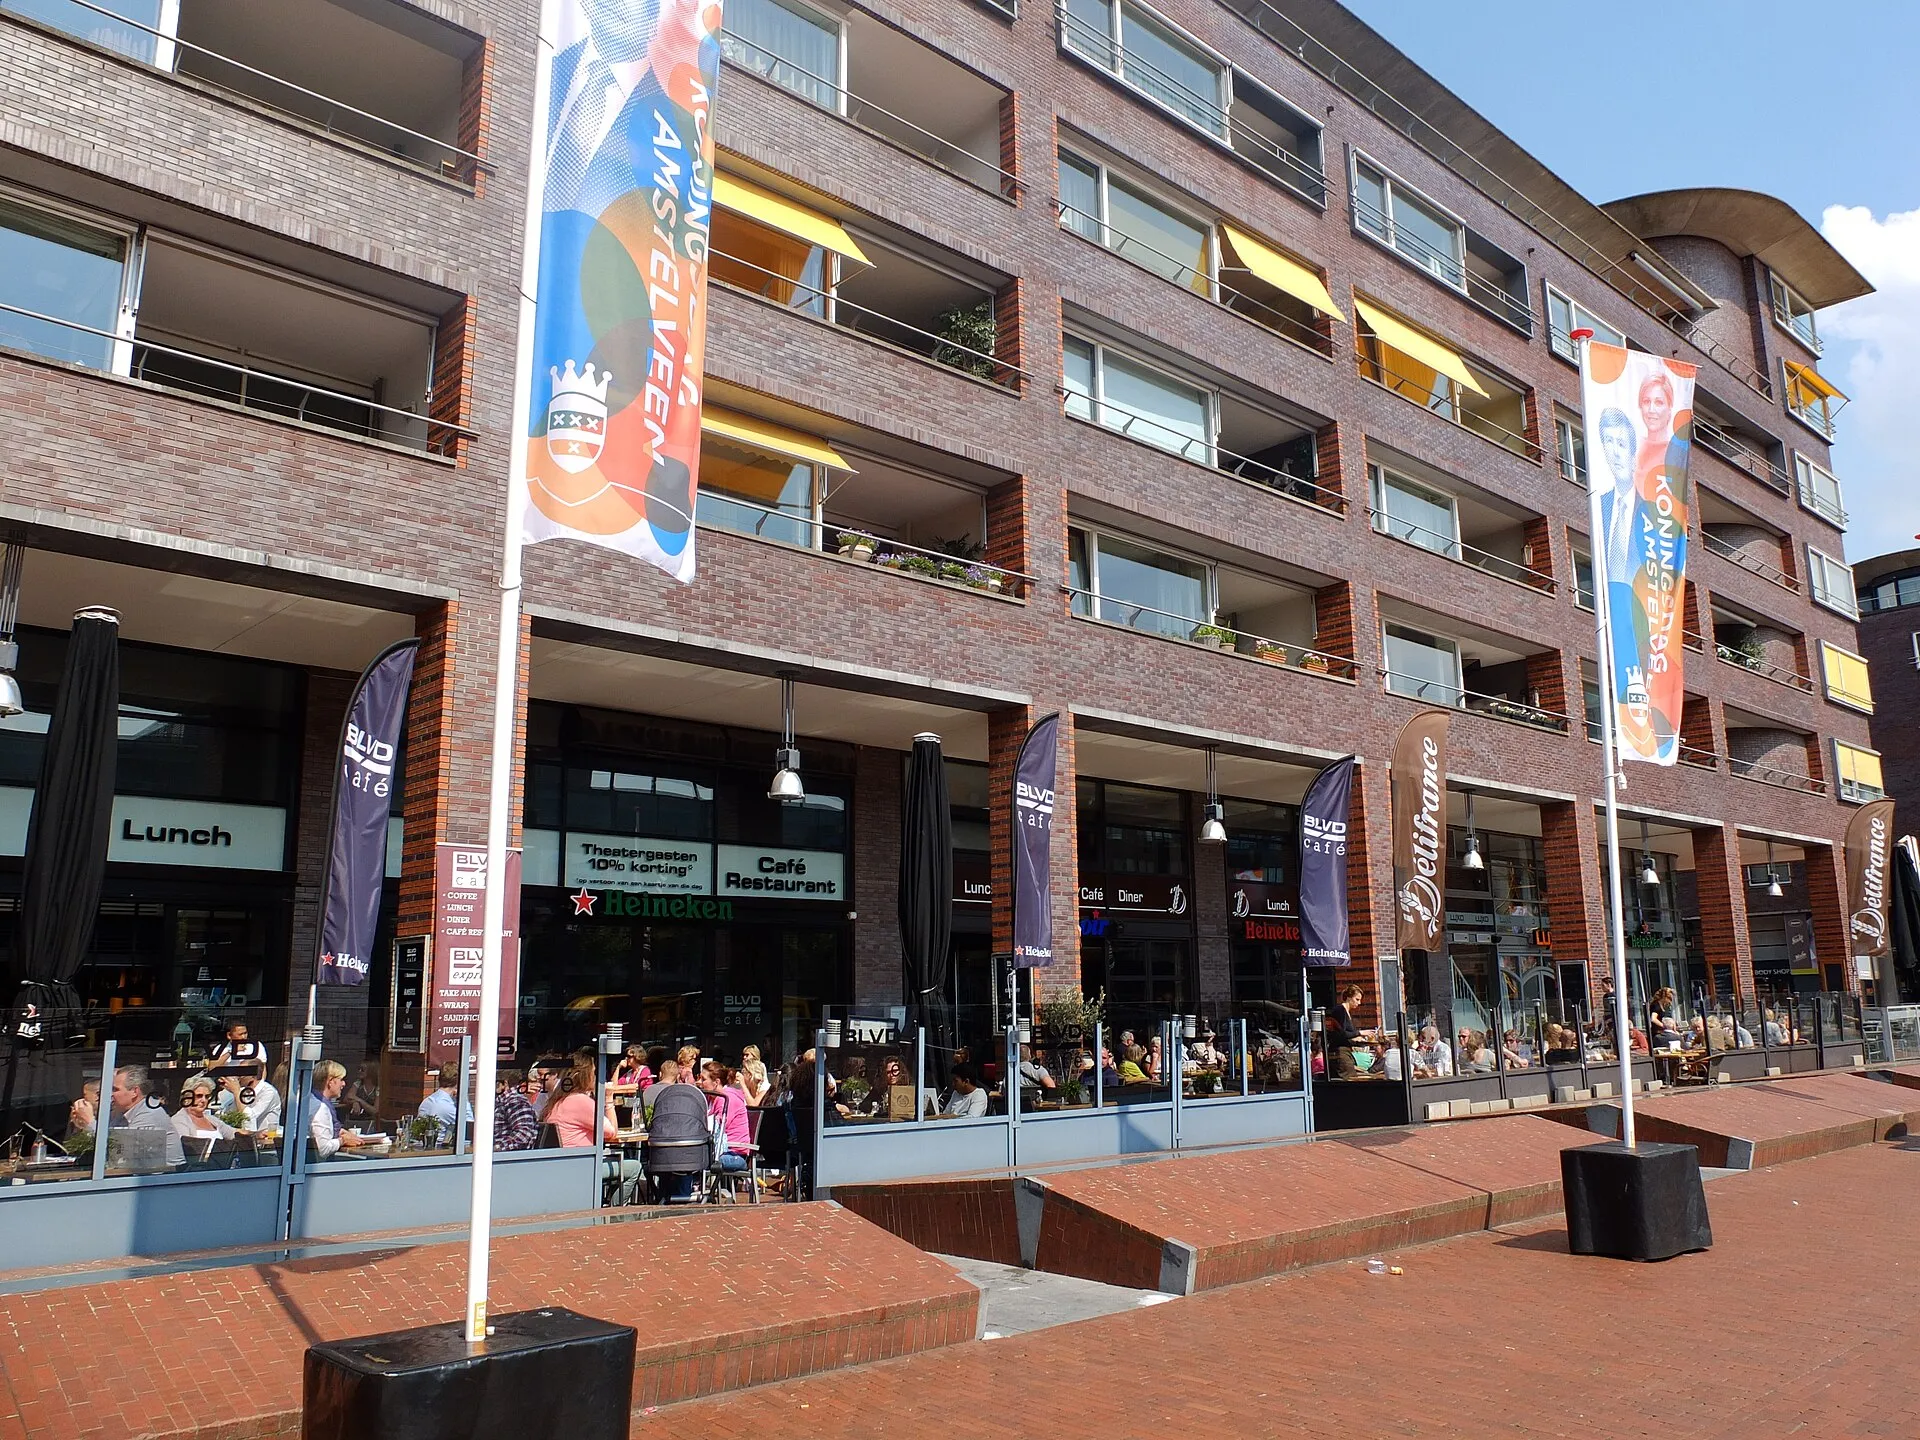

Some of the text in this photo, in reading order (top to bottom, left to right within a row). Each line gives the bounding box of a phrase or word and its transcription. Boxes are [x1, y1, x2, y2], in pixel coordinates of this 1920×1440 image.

[643, 109, 680, 466] AMSTELVEEN
[1653, 474, 1675, 674] KONINGSDAG
[345, 722, 394, 763] BLVD
[1016, 781, 1055, 805] BLVD
[1303, 814, 1347, 834] BLVD
[122, 818, 233, 848] Lunch
[581, 843, 698, 861] Theatergasten
[1303, 838, 1346, 856] café
[456, 853, 488, 866] BLV
[587, 857, 625, 871] 10%
[758, 856, 806, 875] Café
[725, 871, 836, 895] Restaurant
[964, 879, 993, 895] Lunc
[447, 891, 478, 900] COFFEE
[1117, 890, 1144, 904] Diner
[447, 904, 474, 912] LUNCH
[603, 889, 735, 921] Heineken
[1266, 899, 1290, 912] Lunch
[446, 916, 471, 924] DINER
[446, 927, 468, 936] CAFÉ
[1245, 920, 1300, 941] Heineke
[453, 950, 483, 961] BLV
[1307, 948, 1349, 960] Heineken
[439, 989, 460, 997] TAKE
[724, 995, 761, 1006] BLVD
[443, 1001, 470, 1009] WRAPS
[723, 1008, 761, 1025] café
[442, 1026, 468, 1036] JUICES
